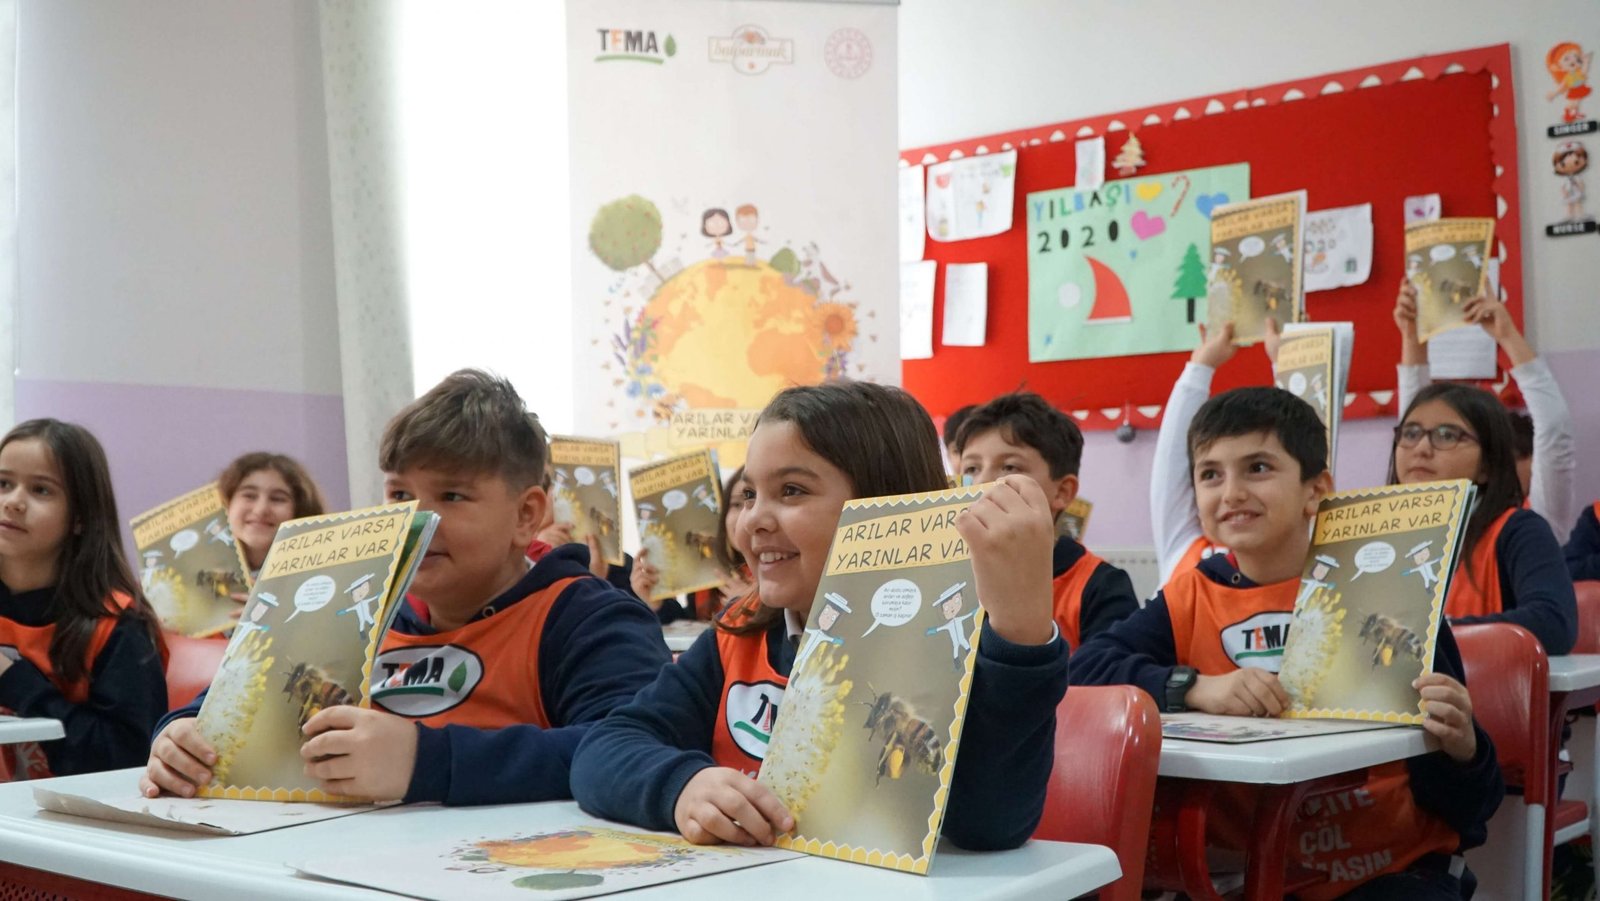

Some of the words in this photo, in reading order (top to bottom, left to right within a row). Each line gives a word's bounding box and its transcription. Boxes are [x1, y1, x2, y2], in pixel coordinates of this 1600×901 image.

[597, 28, 659, 53] TEMA
[1553, 123, 1590, 136] SINGER
[1037, 220, 1119, 253] 2020
[1553, 223, 1585, 234] NURSE
[673, 412, 734, 425] ARILAR
[676, 427, 750, 439] YARINLA
[1324, 502, 1381, 523] ARILAR
[1389, 493, 1445, 512] VARSA
[276, 530, 335, 554] ARILAR
[341, 517, 395, 540] VARSA
[842, 518, 912, 544] ARILAR
[1322, 519, 1401, 541] YARINLAR
[1408, 511, 1442, 527] VAR
[270, 547, 348, 574] YARINLAR
[355, 539, 389, 558] VAR
[835, 543, 933, 570] YARINLAR
[941, 538, 970, 559] VA
